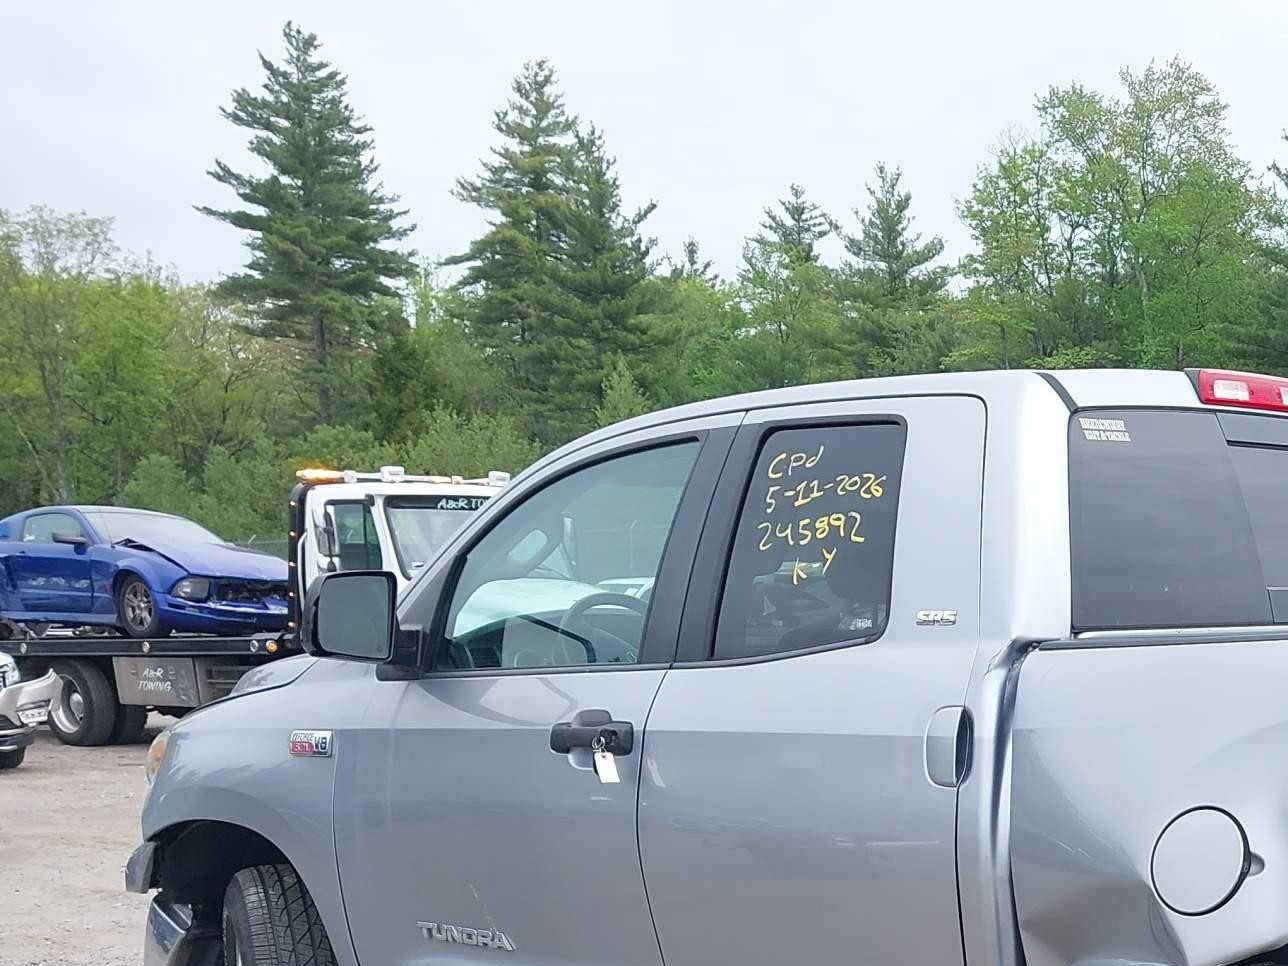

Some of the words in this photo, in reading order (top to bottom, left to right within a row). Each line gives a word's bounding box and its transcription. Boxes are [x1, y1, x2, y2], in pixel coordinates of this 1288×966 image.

[437, 498, 469, 509] A&R
[765, 472, 887, 515] 5-11-2026
[757, 511, 865, 551] 245892
[142, 667, 164, 678] A&R
[138, 680, 172, 693] TOWING
[416, 920, 517, 951] TUNDRA
